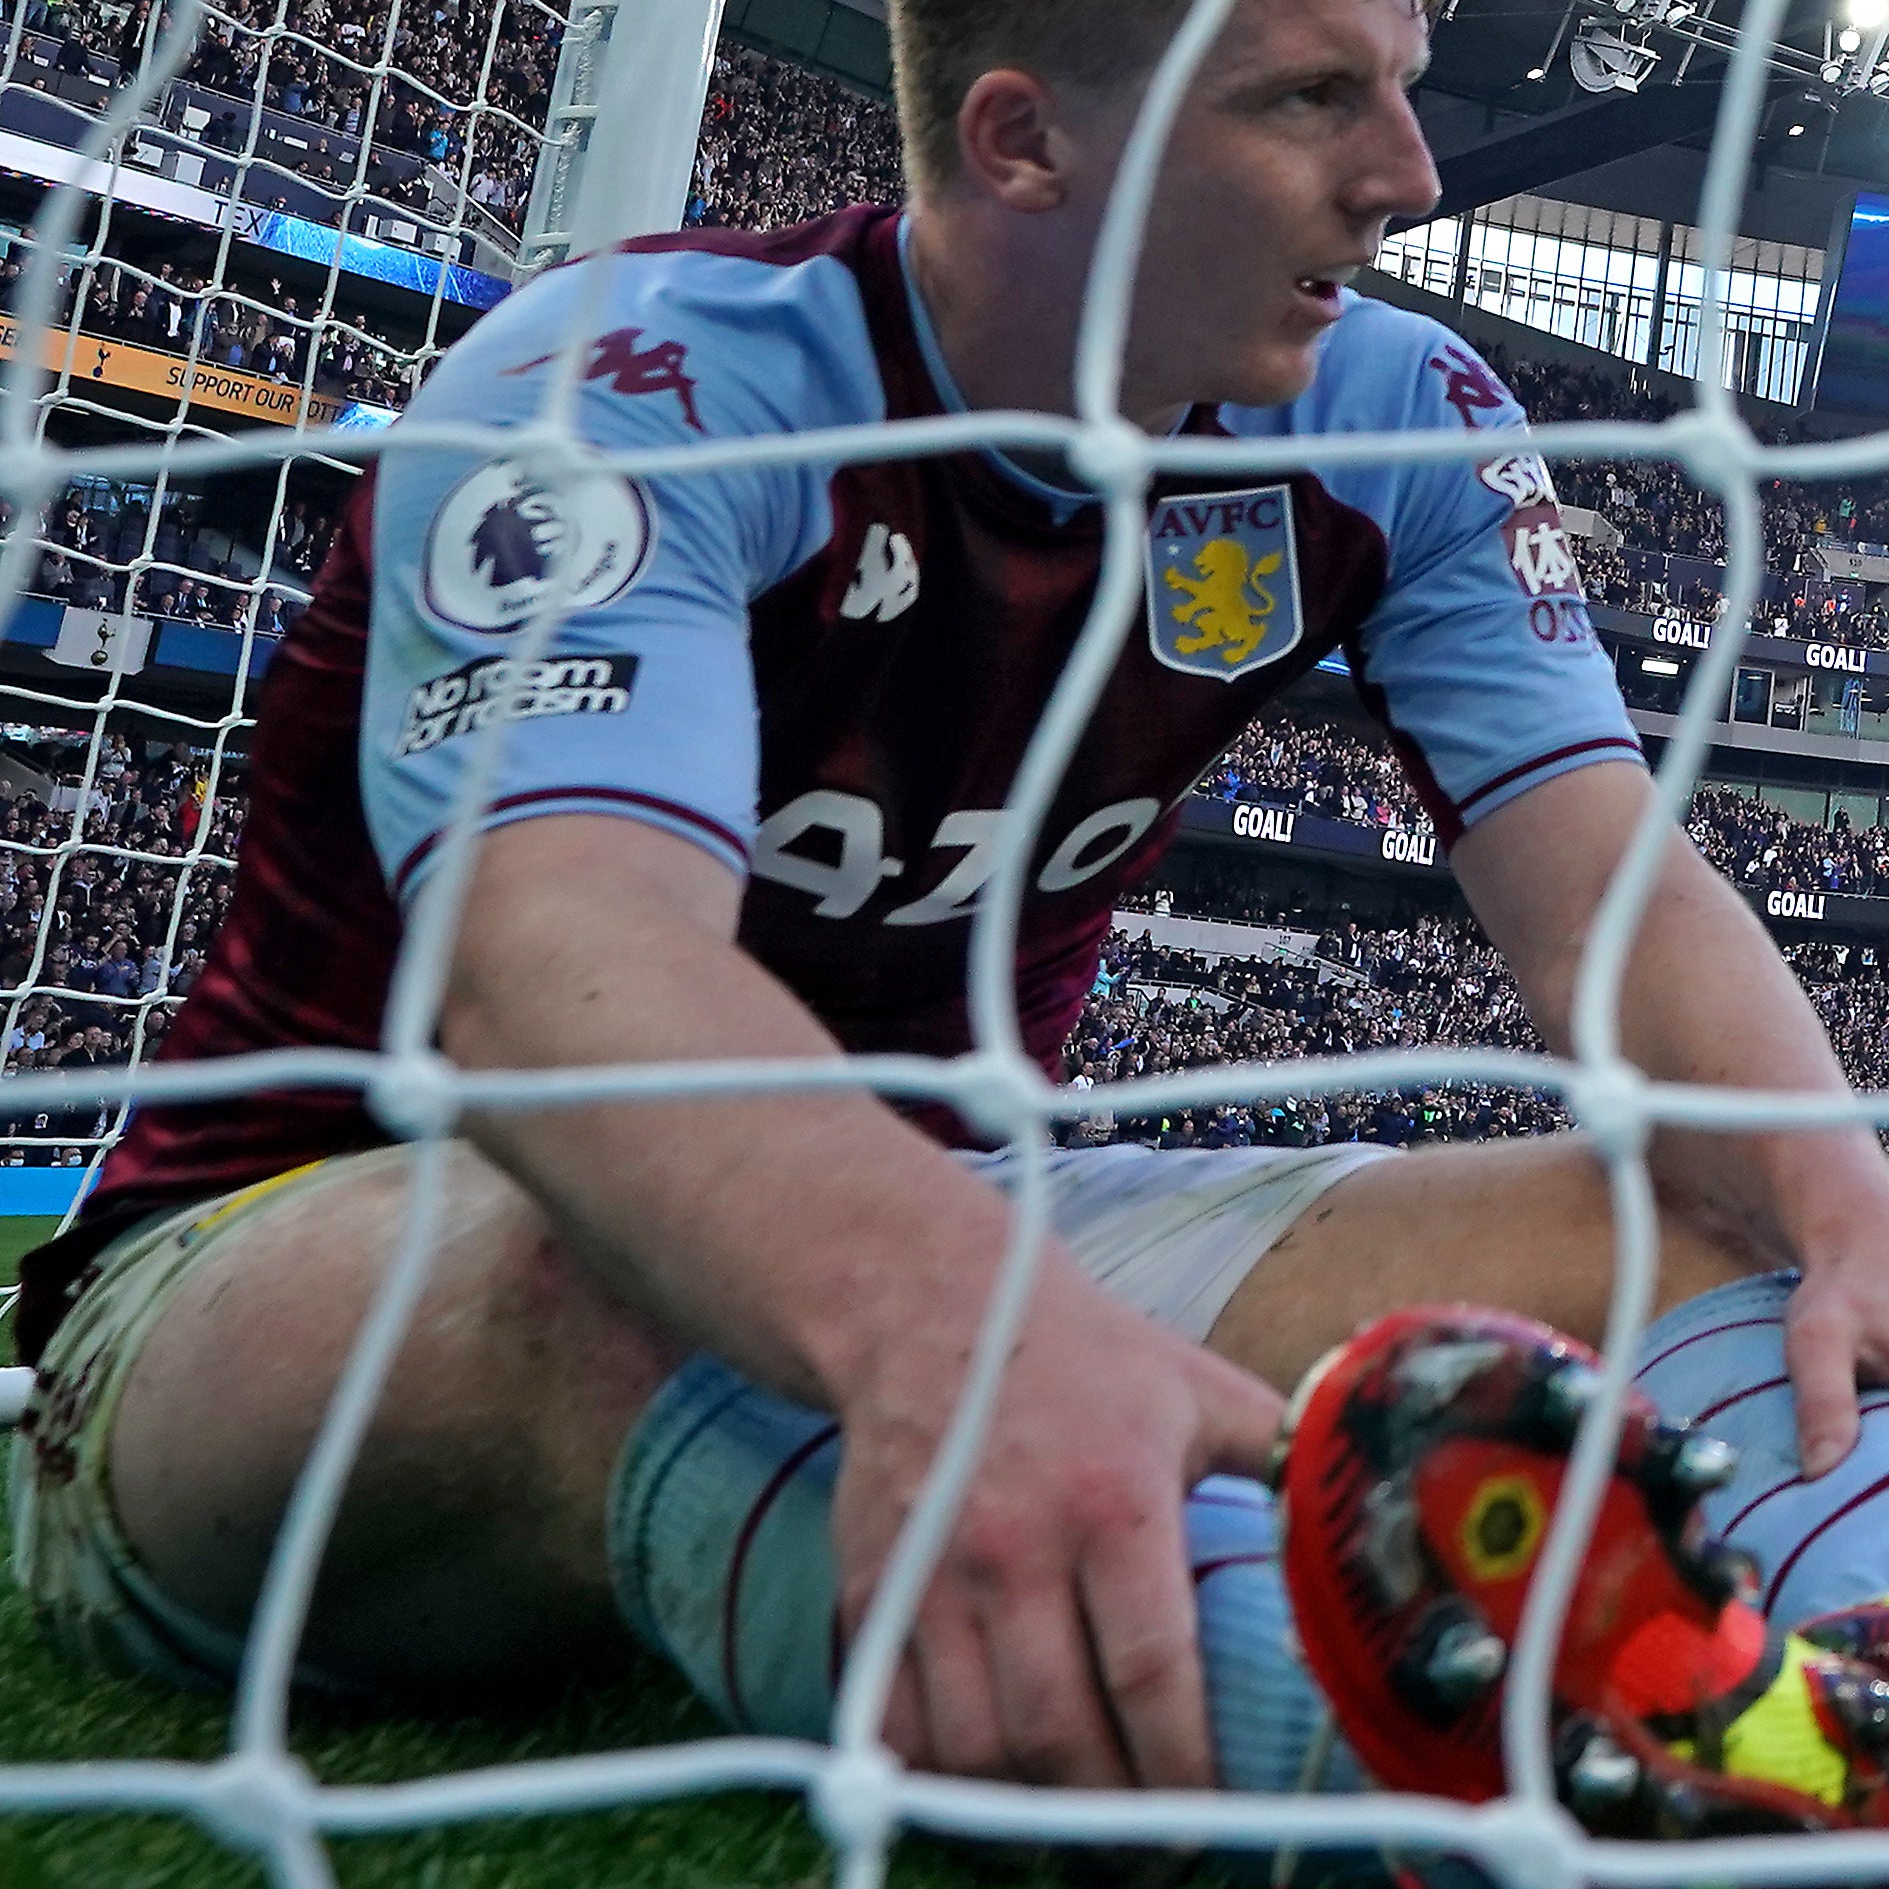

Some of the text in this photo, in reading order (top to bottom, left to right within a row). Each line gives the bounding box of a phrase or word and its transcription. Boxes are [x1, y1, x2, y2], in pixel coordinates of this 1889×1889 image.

[166, 366, 255, 405] SUPPORT
[255, 388, 295, 414] OUR
[1156, 497, 1281, 539] AVFC
[1653, 618, 1711, 650] GOAL!
[1806, 642, 1866, 673] GOAL!
[408, 658, 614, 721] No room
[1234, 803, 1293, 843] GOAL!
[1382, 830, 1435, 867] GOAL!
[1767, 892, 1824, 920] GOAL!
